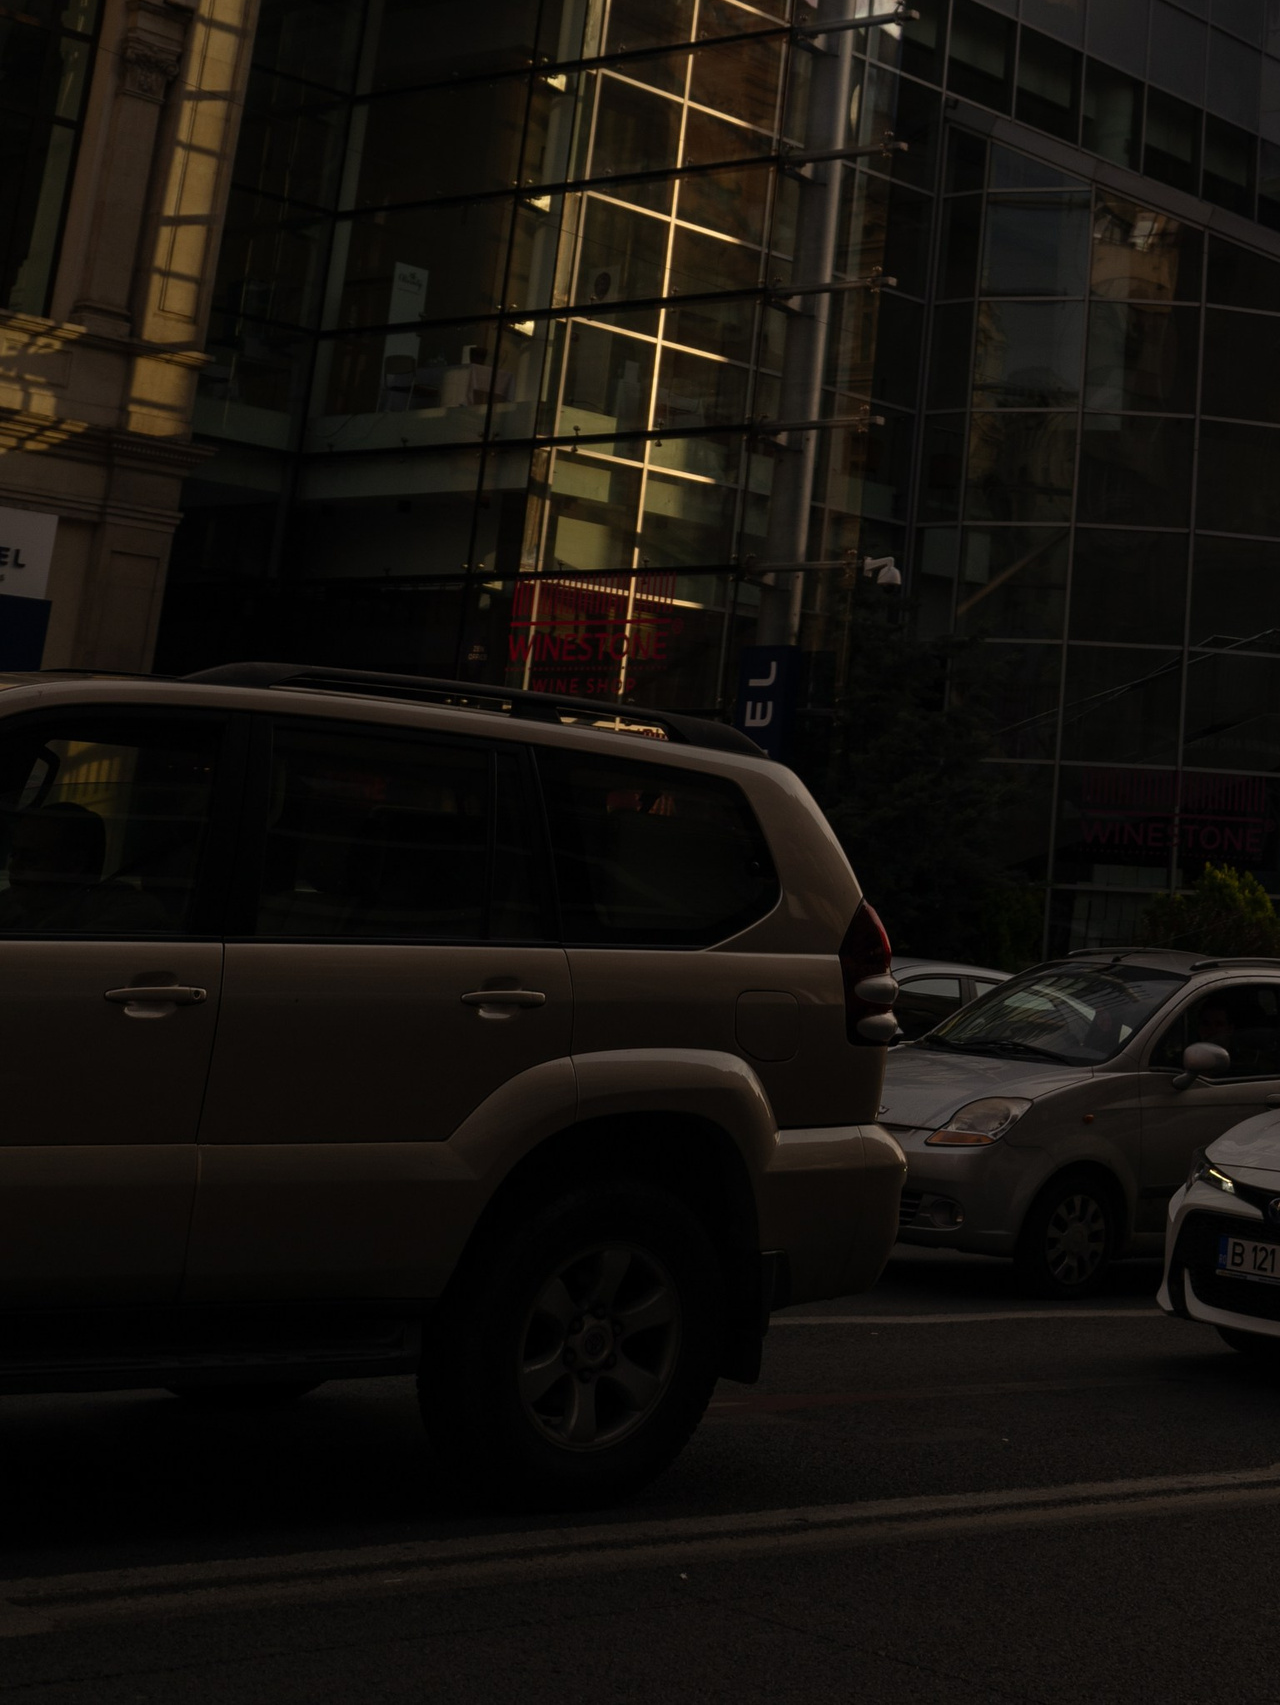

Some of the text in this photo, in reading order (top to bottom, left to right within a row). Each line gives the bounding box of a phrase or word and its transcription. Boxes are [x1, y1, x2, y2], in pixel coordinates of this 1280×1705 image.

[508, 631, 668, 663] WINESTONE
[531, 676, 638, 695] WINE SHOP
[1231, 1241, 1246, 1267] B
[1252, 1244, 1276, 1273] 121
